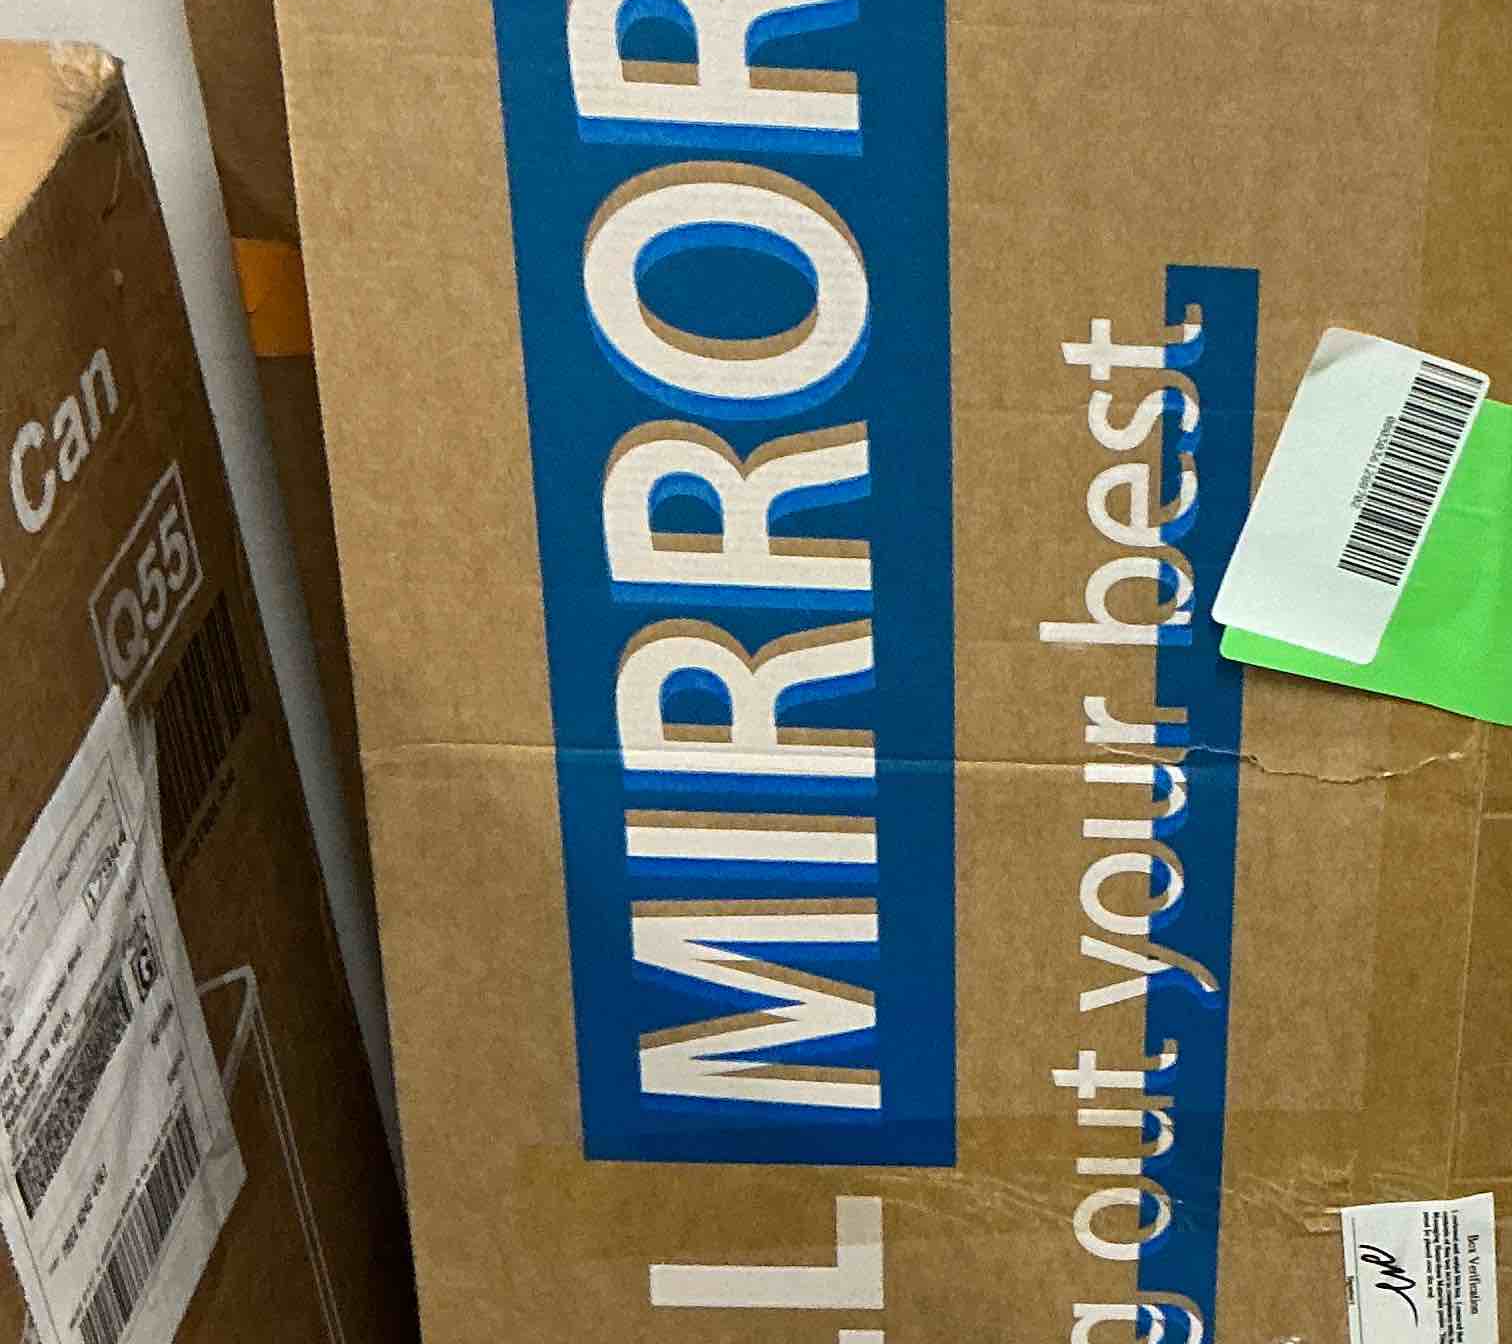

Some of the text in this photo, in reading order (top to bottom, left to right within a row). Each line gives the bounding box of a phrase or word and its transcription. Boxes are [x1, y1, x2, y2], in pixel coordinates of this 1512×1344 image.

[9, 347, 120, 535] Can
[1040, 303, 1201, 646] best.
[106, 503, 191, 682] Q55
[1079, 696, 1219, 1012] your
[1050, 1039, 1180, 1261] out
[1466, 1233, 1481, 1314] Box Verification
